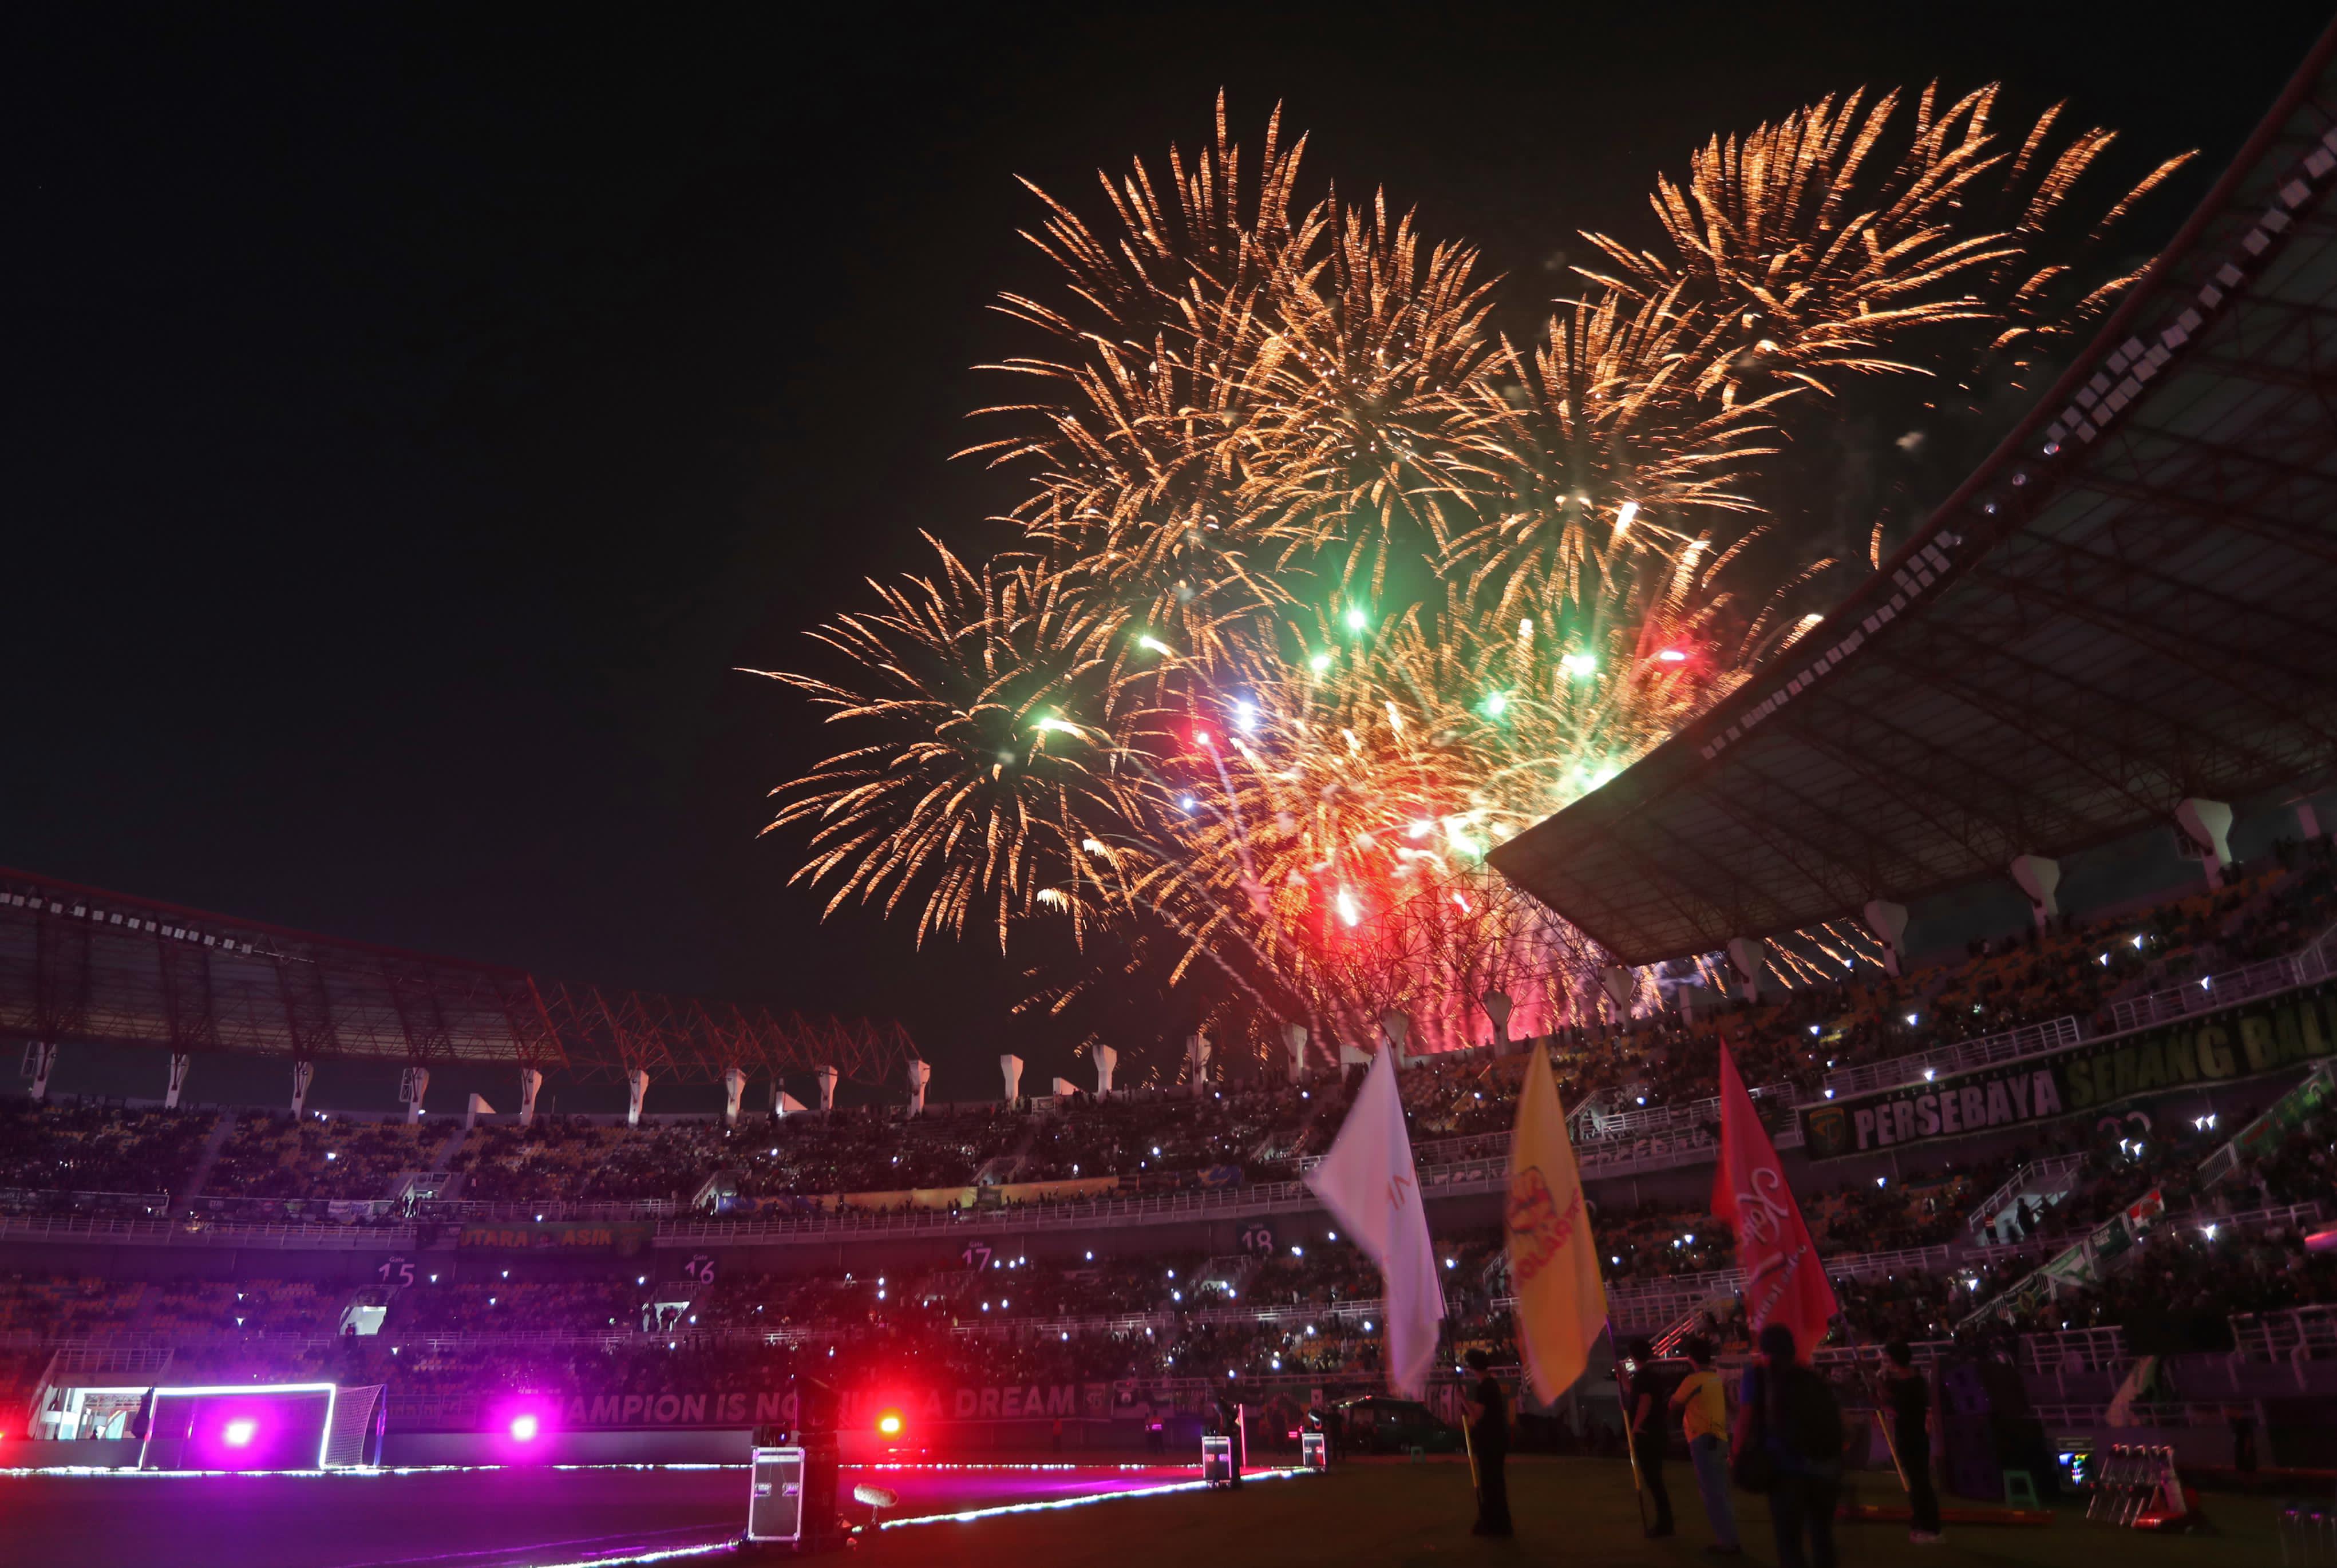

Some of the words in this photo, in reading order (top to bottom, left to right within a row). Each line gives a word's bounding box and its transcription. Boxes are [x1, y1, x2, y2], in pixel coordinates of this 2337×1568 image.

[1854, 1067, 2062, 1150] PERSEBAYA
[2066, 1024, 2237, 1107] SERANG
[460, 1229, 528, 1247] UTARA
[1241, 1229, 1273, 1256] 18
[684, 1260, 715, 1285] 16
[961, 1247, 992, 1273] 17
[378, 1262, 416, 1289] 15
[715, 1392, 746, 1422] IS
[954, 1383, 1077, 1418] DREAM
